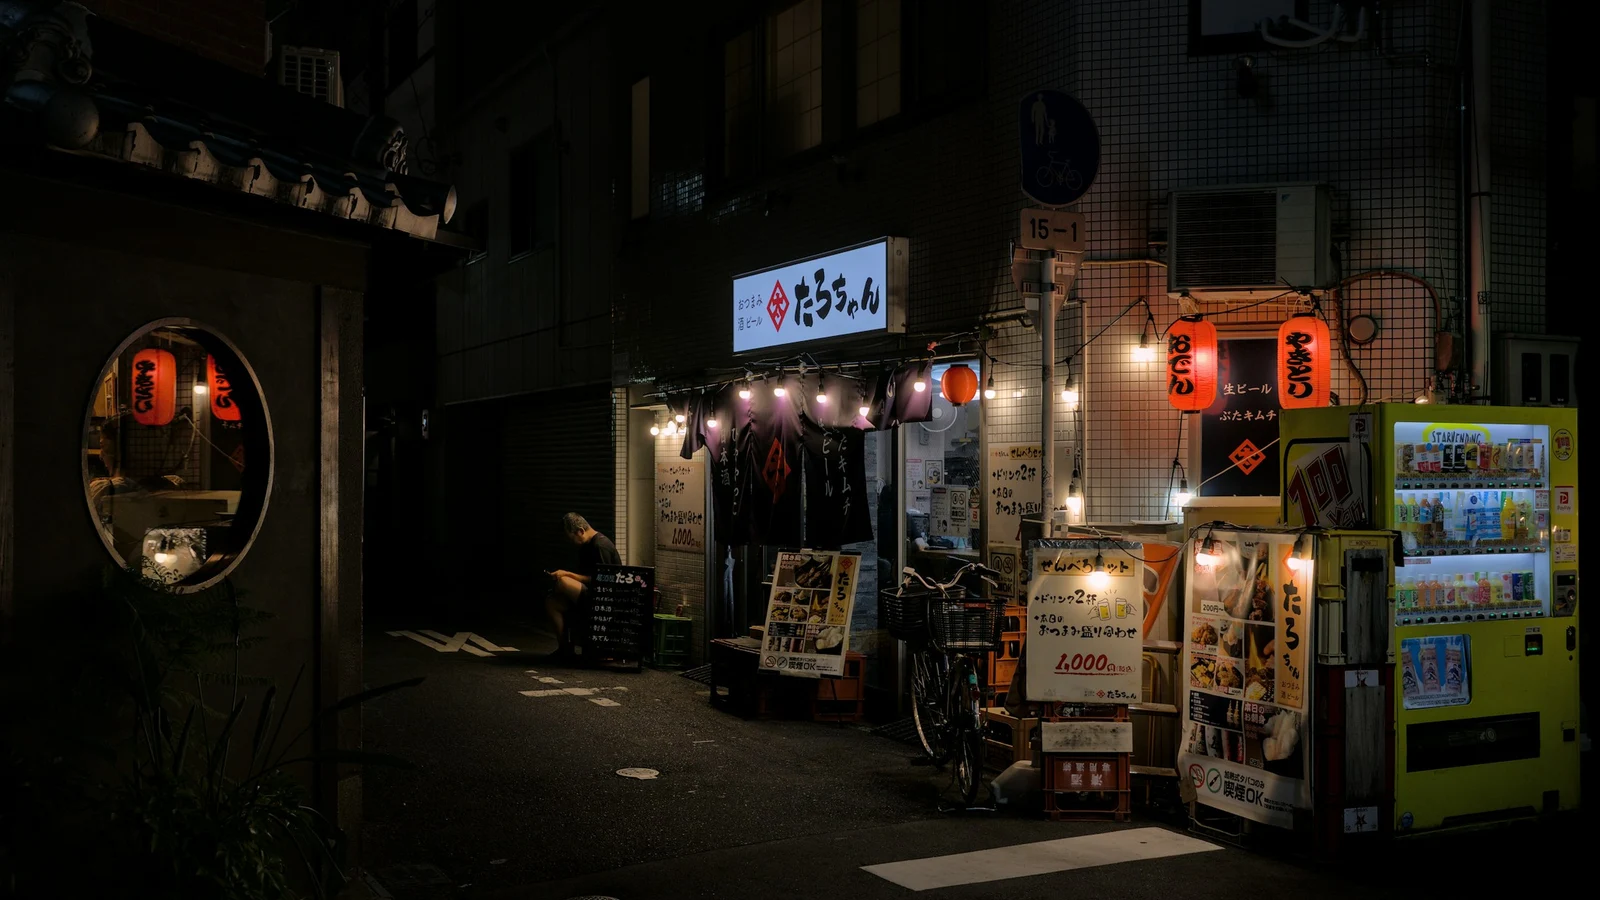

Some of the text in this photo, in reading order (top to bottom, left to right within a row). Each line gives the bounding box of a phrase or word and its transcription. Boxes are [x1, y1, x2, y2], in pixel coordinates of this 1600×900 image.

[738, 294, 763, 311] おつまみ
[794, 268, 880, 328] たろちゃん
[1168, 333, 1194, 395] おでん
[1286, 332, 1313, 399] やきとり
[1223, 383, 1272, 395] 生ビール
[1219, 410, 1277, 421] ぶたキムチ
[996, 464, 1036, 482] ドリンク2杯
[1287, 444, 1352, 526] 100
[1041, 559, 1129, 573] せんべろット
[1040, 589, 1097, 605] ドリンク2杯
[1040, 614, 1064, 623] 本日の
[1039, 625, 1137, 638] おつまみ盛り合わせ
[1282, 580, 1301, 679] たろちゃん
[788, 661, 816, 671] 喫煙OK
[1107, 690, 1137, 699] たろちゃん
[1223, 780, 1264, 806] 喫煙OK
